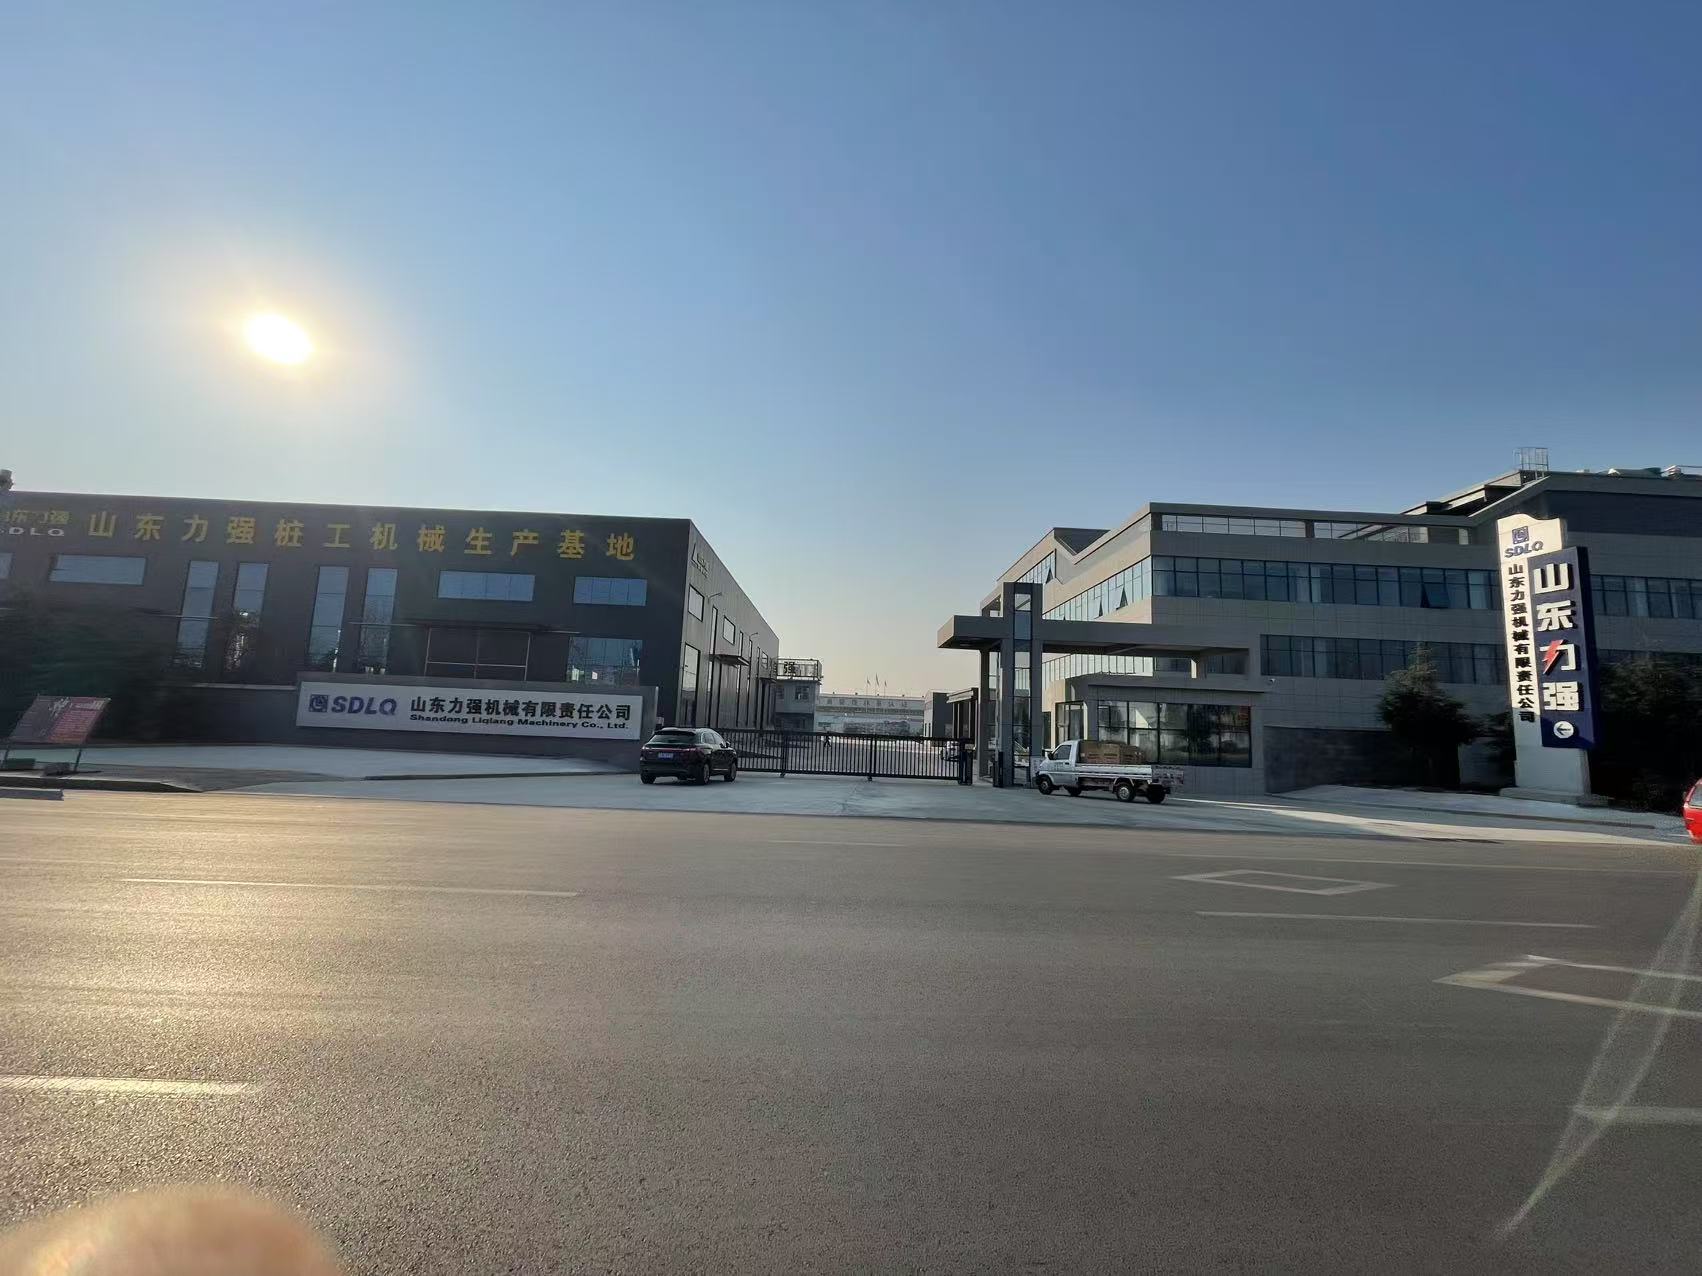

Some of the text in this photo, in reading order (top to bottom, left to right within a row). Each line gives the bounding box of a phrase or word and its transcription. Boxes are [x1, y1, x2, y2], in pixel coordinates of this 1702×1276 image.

[87, 510, 635, 561] 山东力强桩工机械生产基地
[1505, 540, 1544, 558] SDLQ
[1508, 563, 1536, 722] 山东力强机械有限责任公司
[1533, 562, 1580, 711] 山东力强
[331, 696, 397, 715] SDLQ
[410, 696, 631, 720] 山东力强机械有限责任公司
[409, 714, 468, 724] Shandong
[472, 716, 514, 726] Liqiang
[517, 719, 578, 728] Machinery
